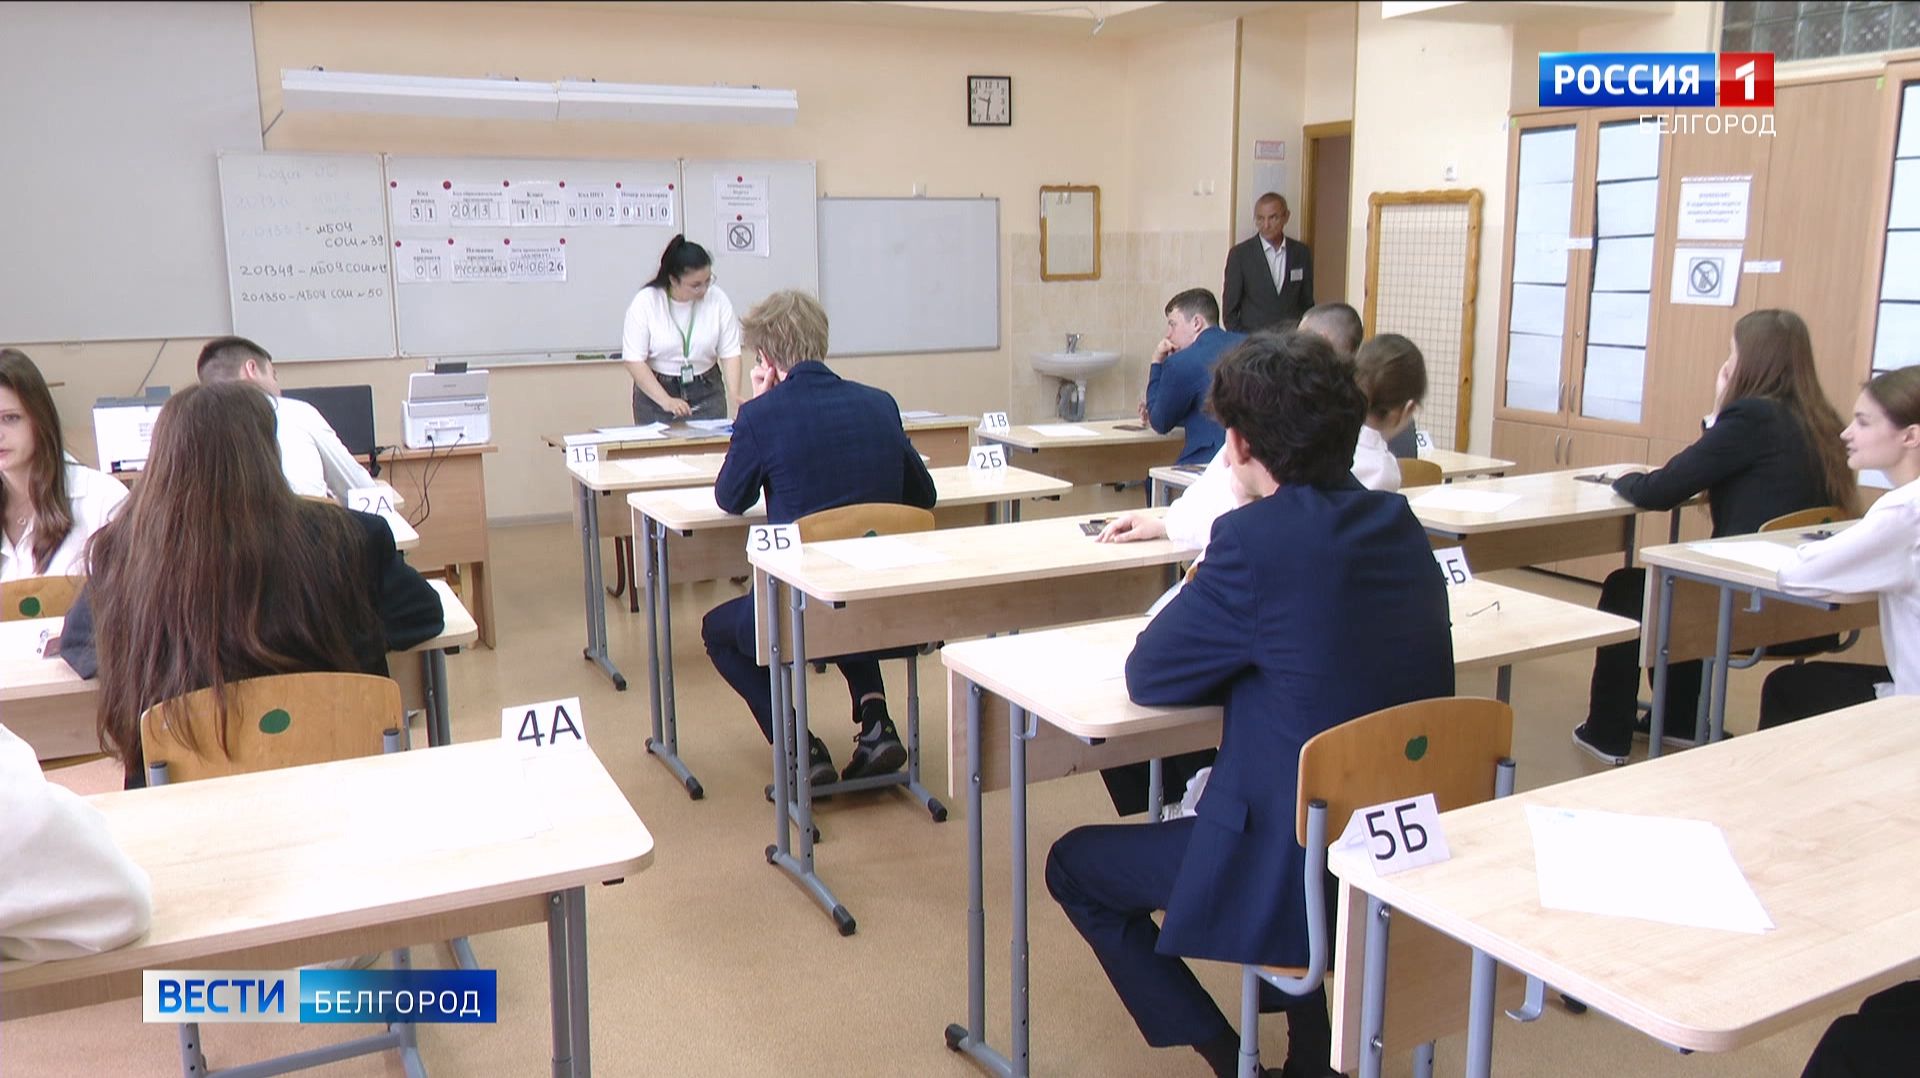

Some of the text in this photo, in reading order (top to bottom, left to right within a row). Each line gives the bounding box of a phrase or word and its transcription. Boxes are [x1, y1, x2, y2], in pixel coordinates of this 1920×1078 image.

[989, 414, 1007, 428] 1В
[572, 447, 597, 464] 1Б
[976, 451, 1002, 469] 2Б
[358, 495, 393, 516] 2А
[754, 527, 792, 552] 3Б
[517, 705, 582, 747] 4А
[1365, 802, 1428, 861] 5Б
